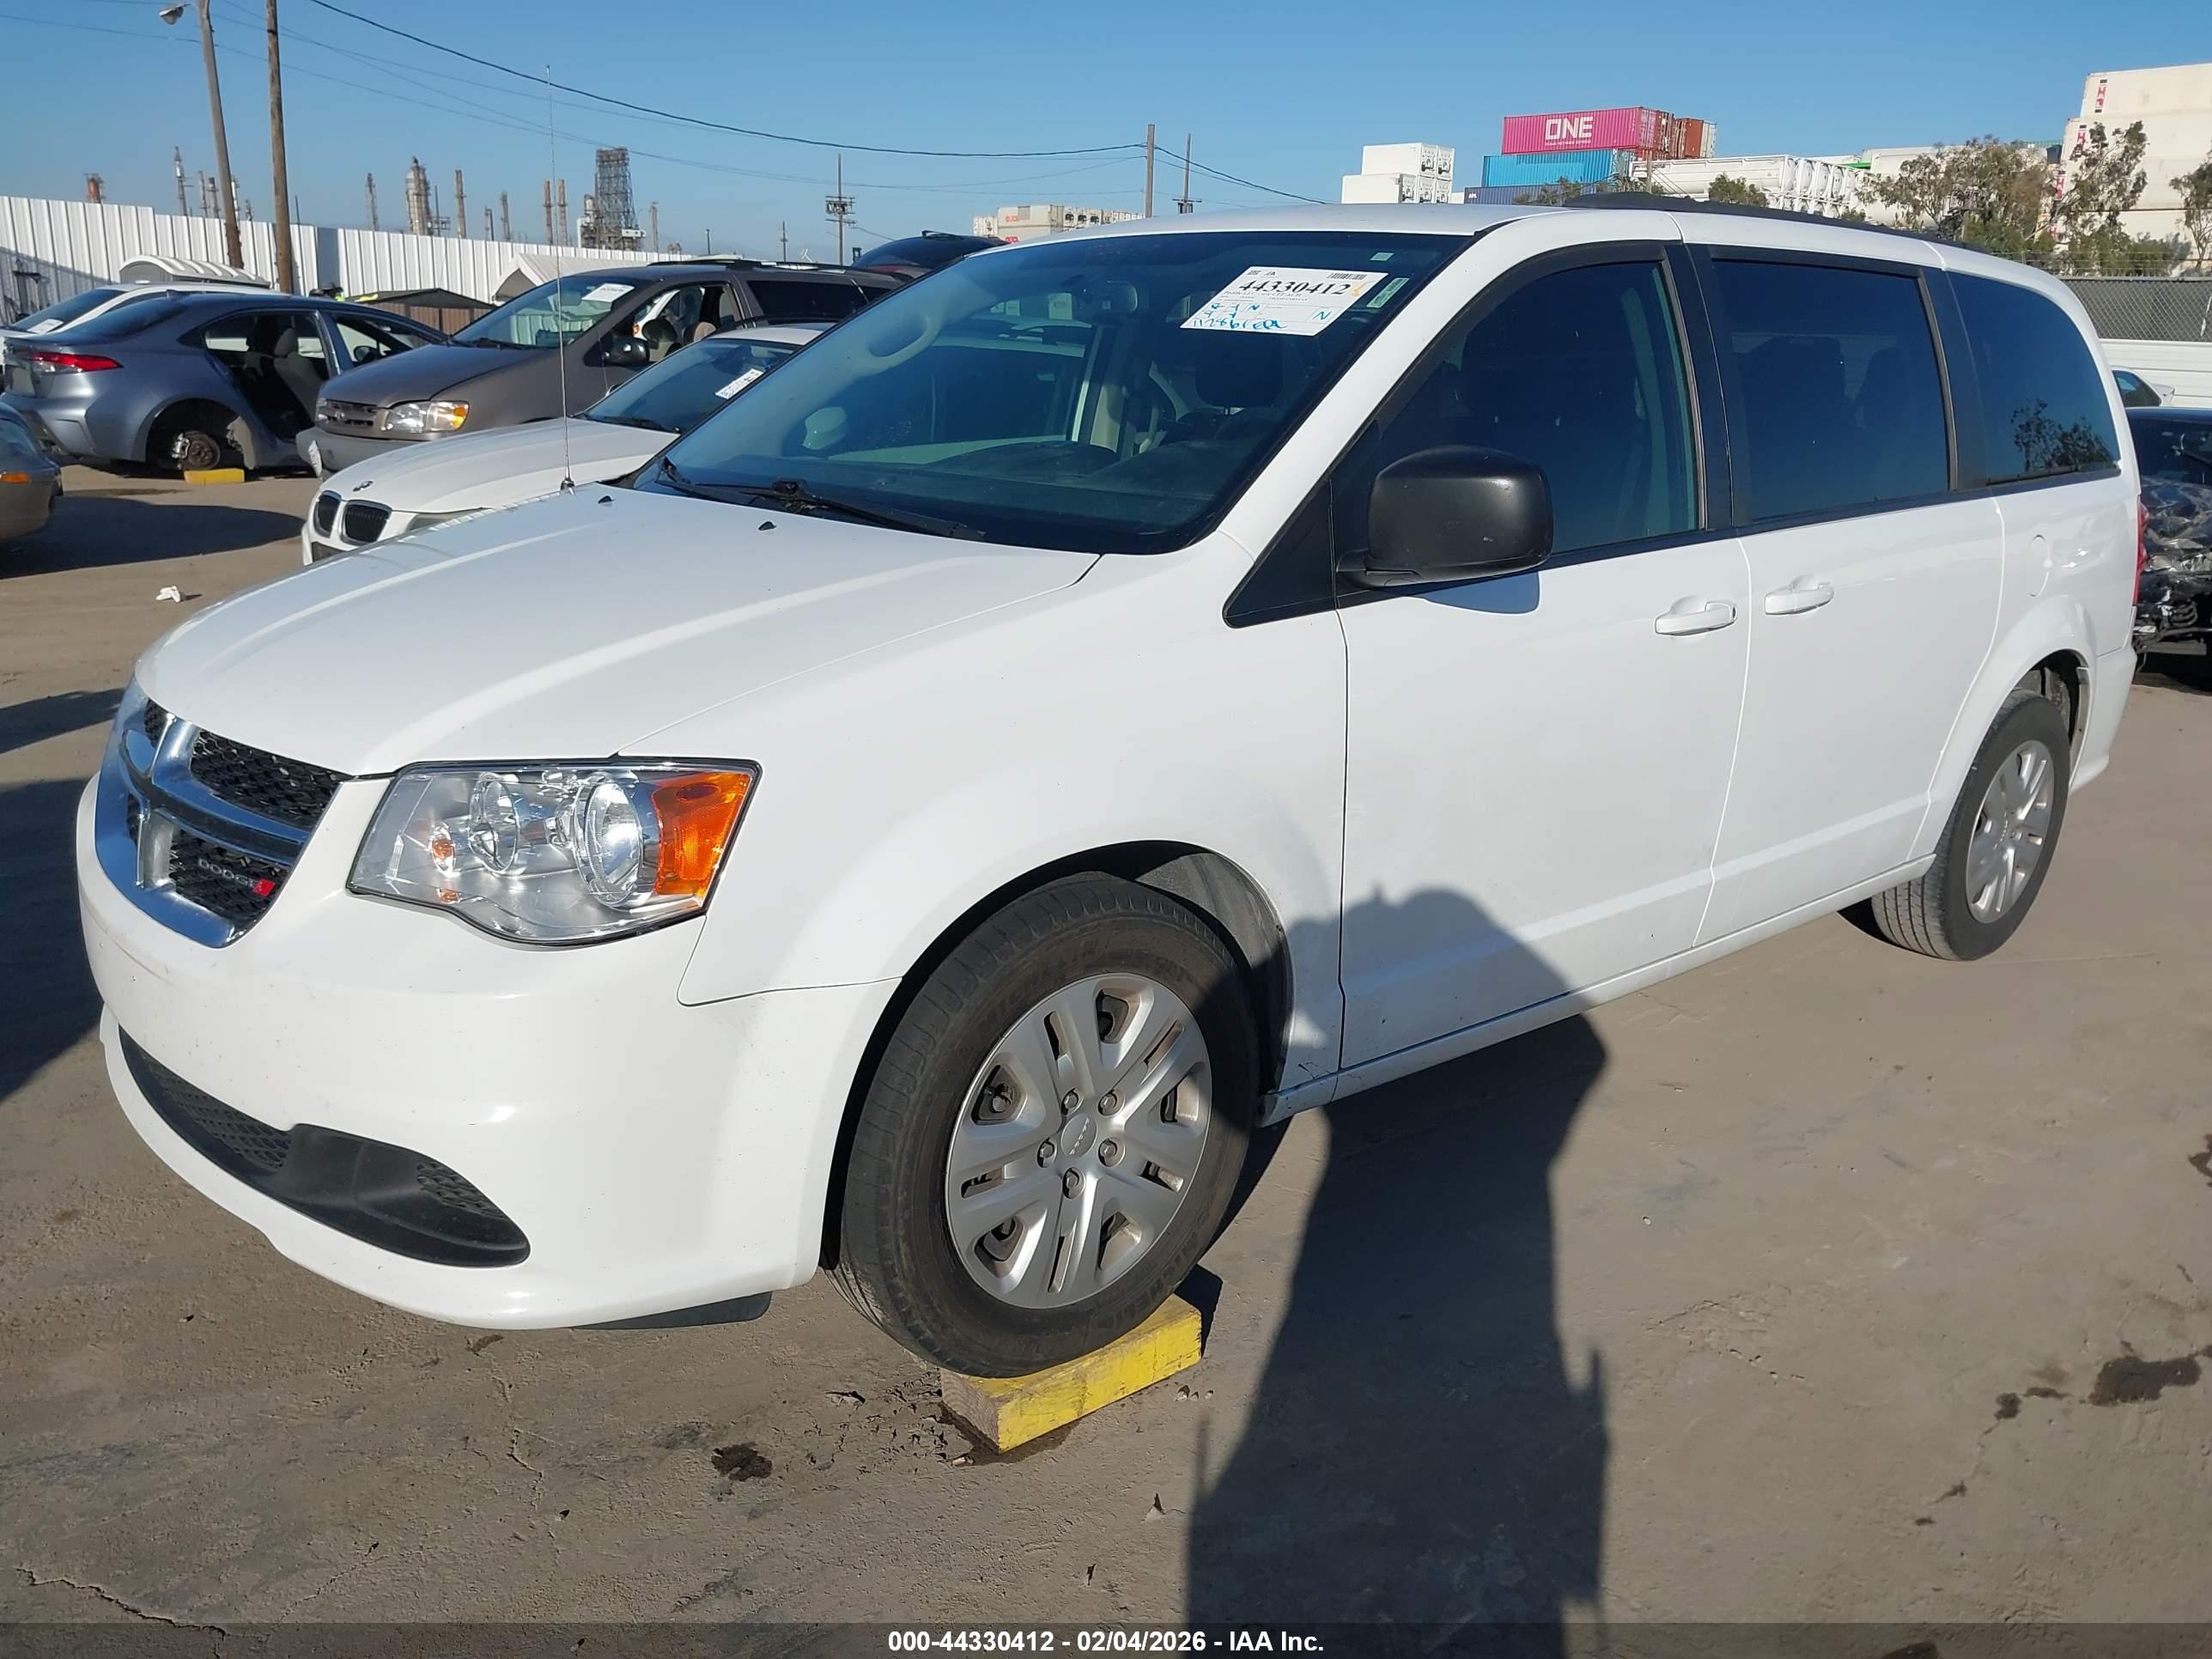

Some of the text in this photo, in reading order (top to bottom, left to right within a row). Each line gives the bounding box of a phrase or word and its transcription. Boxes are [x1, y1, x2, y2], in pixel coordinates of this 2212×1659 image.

[1546, 116, 1594, 141] ONE
[1238, 280, 1352, 295] 44330412
[198, 858, 256, 889] DODGE
